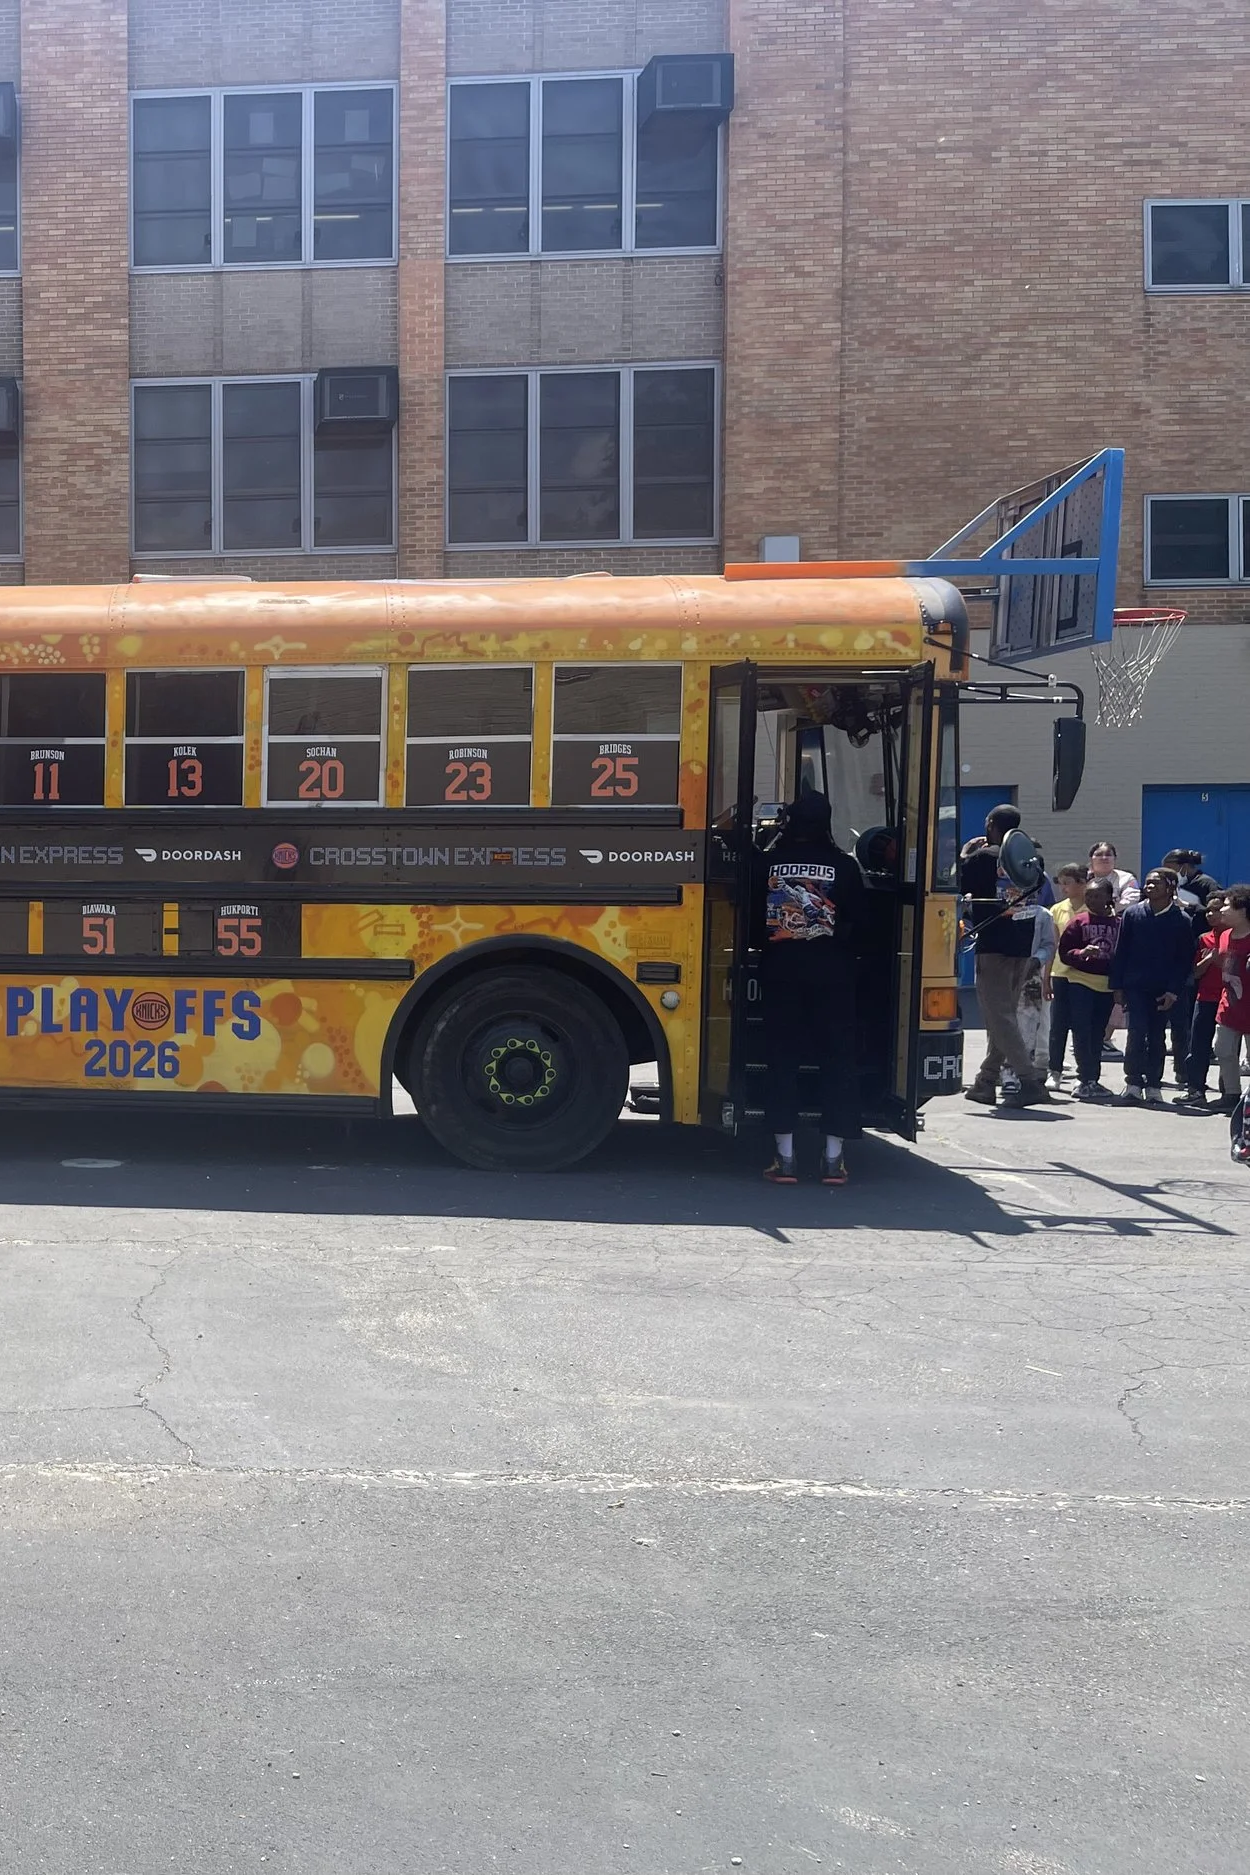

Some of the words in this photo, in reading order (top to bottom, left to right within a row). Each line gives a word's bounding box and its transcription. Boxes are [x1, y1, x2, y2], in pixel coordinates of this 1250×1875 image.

[30, 749, 65, 761] BRUNSON
[173, 746, 197, 757] KOLEK
[306, 746, 337, 758] SOCHAN
[448, 748, 488, 760] ROBINSON
[599, 743, 632, 755] BRIDGES
[33, 762, 60, 800] 11
[167, 759, 203, 797] 13
[298, 760, 345, 798] 20
[445, 762, 492, 800] 23
[590, 757, 639, 797] 25
[19, 846, 124, 865] EXPRESS
[162, 850, 242, 861] DOORDASH
[309, 847, 449, 866] CROSSTOWN
[608, 851, 695, 862] DOORDASH
[771, 864, 834, 879] HOOPBUS
[82, 903, 117, 915] DIAWARA
[220, 904, 259, 916] HUKPORTI
[82, 917, 116, 955] 51
[217, 918, 262, 957] 55
[135, 1002, 167, 1020] KNICKS
[84, 1039, 180, 1079] 2026
